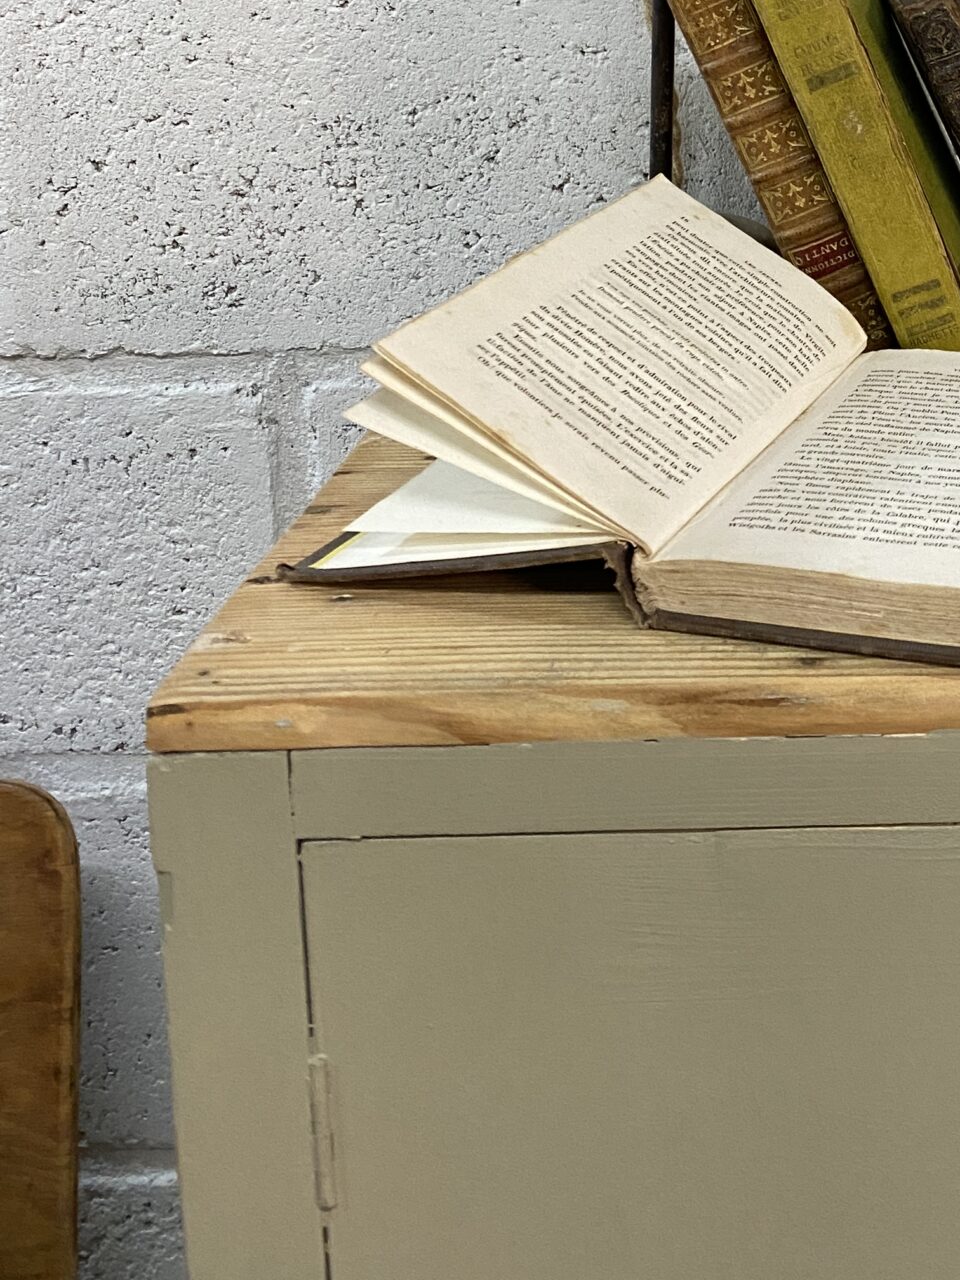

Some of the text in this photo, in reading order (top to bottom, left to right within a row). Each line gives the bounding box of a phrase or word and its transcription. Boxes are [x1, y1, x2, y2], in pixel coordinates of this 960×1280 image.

[610, 258, 638, 278] errants
[637, 277, 651, 288] sur
[651, 286, 663, 296] les
[663, 295, 703, 325] montagnes
[703, 324, 733, 347] voisines
[732, 346, 752, 361] qu'il
[757, 365, 772, 378] fait
[771, 377, 787, 393] dire
[626, 259, 638, 269] En
[686, 303, 709, 319] point
[715, 322, 744, 345] l'aspect
[743, 343, 757, 355] des
[757, 354, 793, 387] troupeaux
[631, 244, 805, 377] campagne dont les riantes images ont passé dans
[667, 231, 827, 357] On nous dit encore que la maison de Virgile
[801, 249, 855, 274] DICTIONN
[476, 343, 491, 354] ser
[494, 331, 523, 352] furent
[519, 352, 577, 394] promptement
[616, 422, 659, 455] L'exercice
[658, 454, 669, 462] et
[669, 460, 678, 470] la
[512, 333, 544, 358] Ensuite
[544, 358, 565, 374] nous
[566, 374, 610, 407] songeâmes
[619, 413, 635, 425] nos
[635, 425, 680, 460] provisions,
[683, 460, 702, 473] qui
[521, 315, 540, 330] tour
[541, 331, 579, 359] plusieurs
[582, 360, 600, 375] vers
[601, 374, 616, 387] des
[662, 420, 673, 428] et
[673, 427, 689, 440] des
[530, 309, 722, 452] son mausolée en faisant redire aux échos d'alen-
[538, 303, 730, 446] du divin Homère, nous avons jeté des fleurs sur
[556, 304, 737, 440] Pénétré de respect et d'admiration pour le rival
[493, 369, 512, 382] que
[511, 381, 554, 413] volontiers
[551, 410, 563, 421] je
[563, 420, 590, 440] serais
[590, 441, 621, 464] revenu
[620, 464, 649, 485] passer
[649, 484, 669, 499] plu-
[526, 366, 538, 377] de
[538, 377, 563, 397] l'âme
[563, 396, 576, 406] ne
[577, 406, 621, 439] manquent
[619, 437, 650, 461] jamais
[652, 461, 685, 485] d'aigui-
